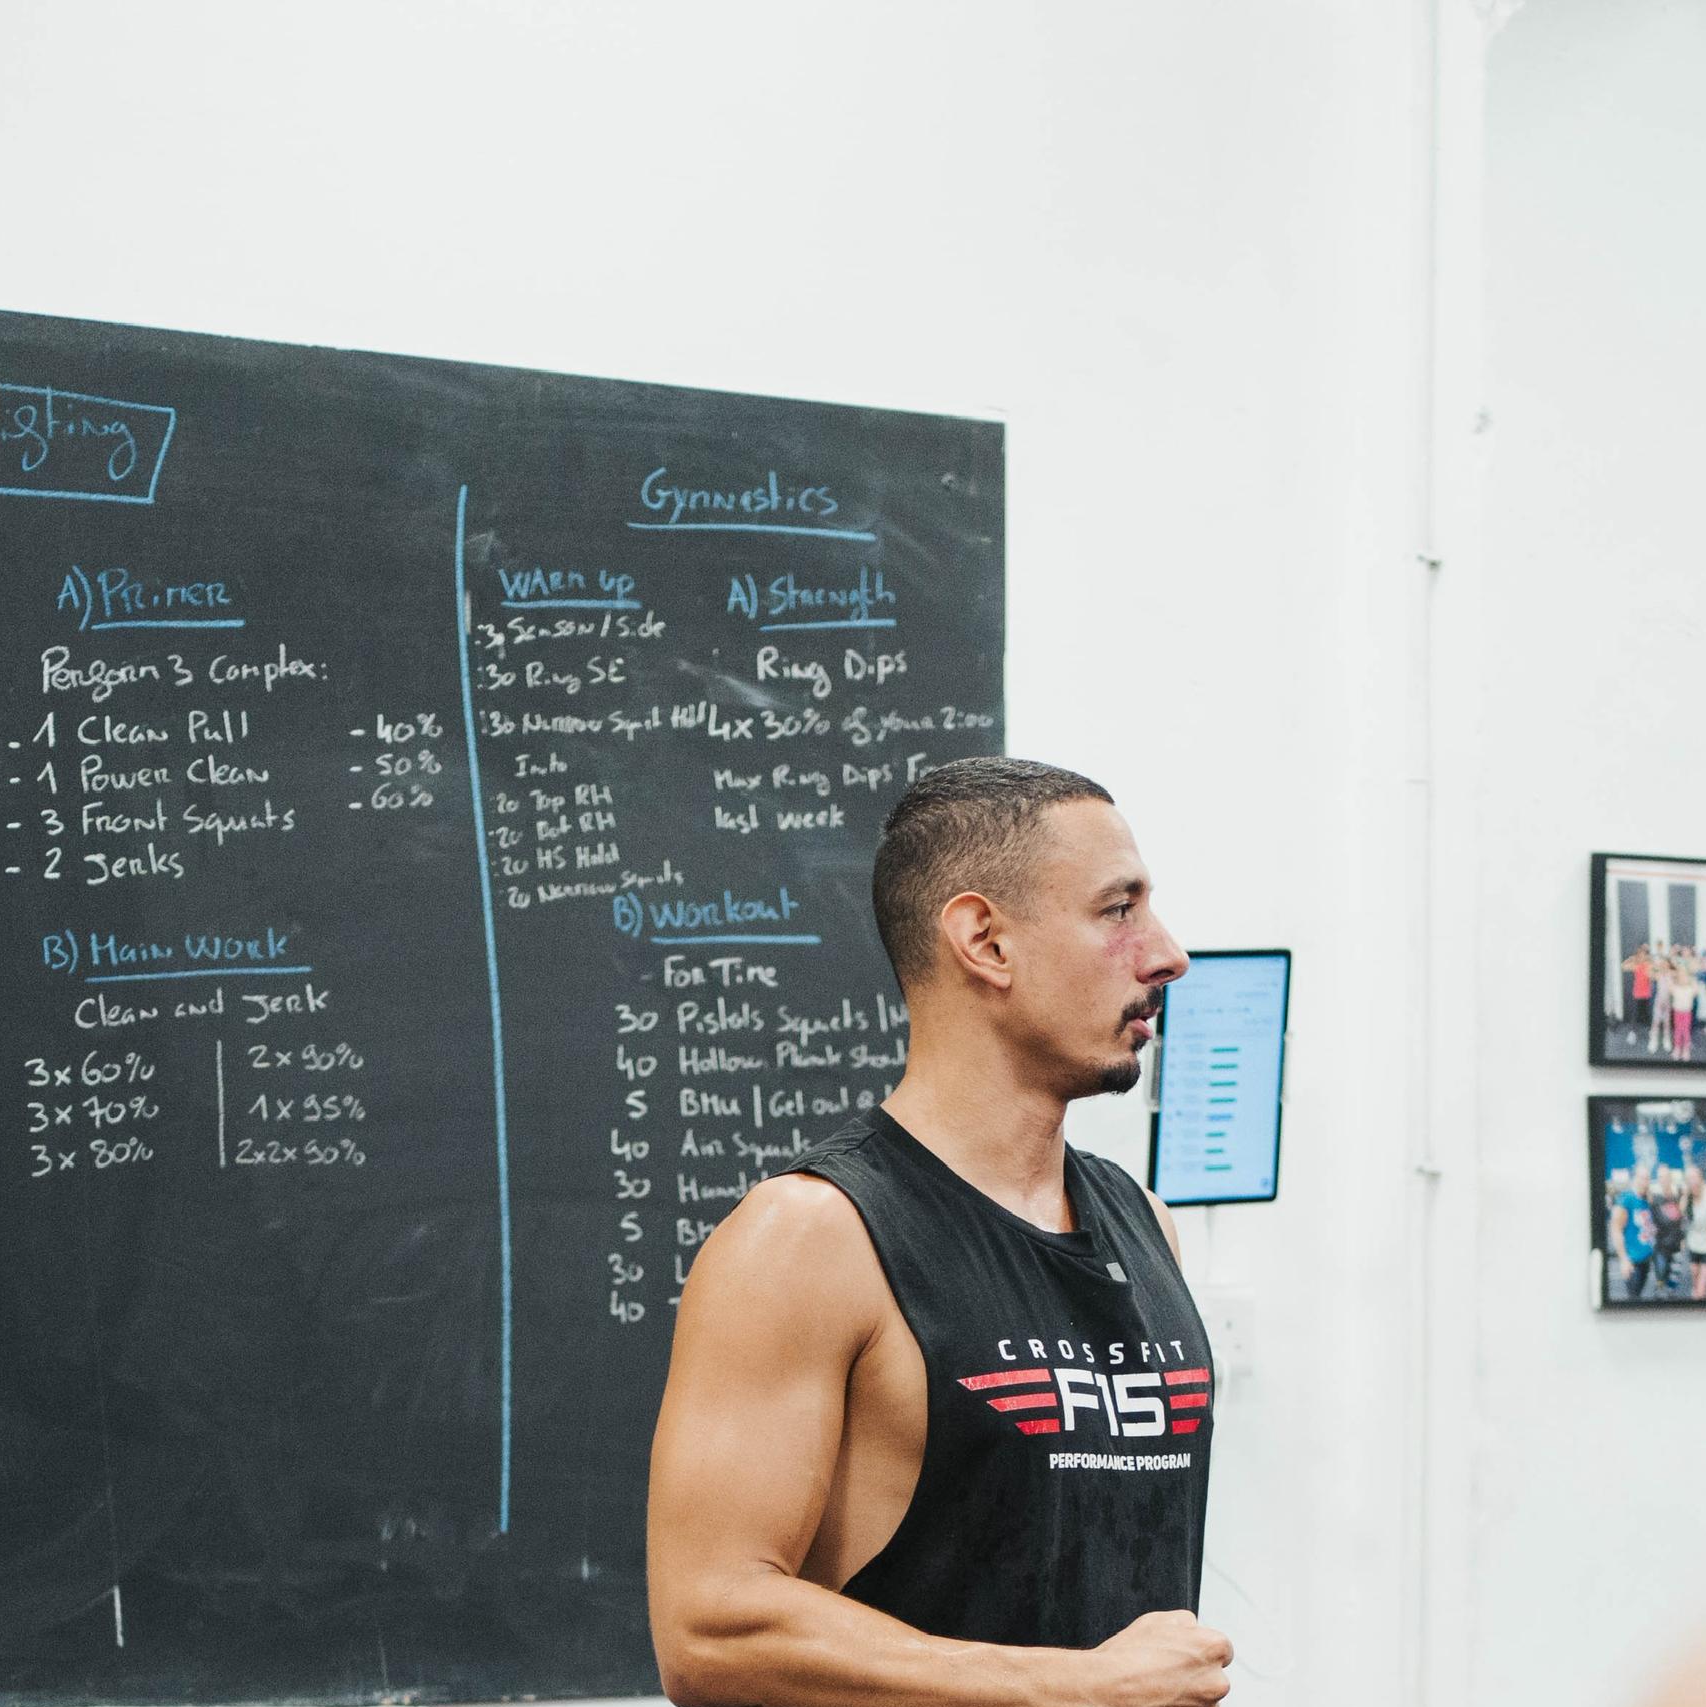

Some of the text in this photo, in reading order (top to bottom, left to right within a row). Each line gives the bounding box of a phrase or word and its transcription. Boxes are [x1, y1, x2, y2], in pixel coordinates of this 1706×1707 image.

[168, 654, 193, 687] 3
[757, 646, 908, 698] Ring Dips
[77, 714, 169, 745] Clean
[188, 709, 249, 744] Pull
[81, 753, 170, 793] Power
[187, 757, 270, 785] Clean
[843, 763, 893, 793] Dips
[82, 799, 168, 836] Front
[75, 992, 158, 1029] Clean
[174, 987, 224, 1017] and
[614, 1004, 659, 1034] 30
[616, 1045, 658, 1081] 40
[610, 1128, 649, 1162] 40
[613, 1170, 651, 1199] 30
[608, 1253, 643, 1285] 30
[609, 1290, 645, 1323] 40
[1049, 1453, 1136, 1471] PERFORMANCE
